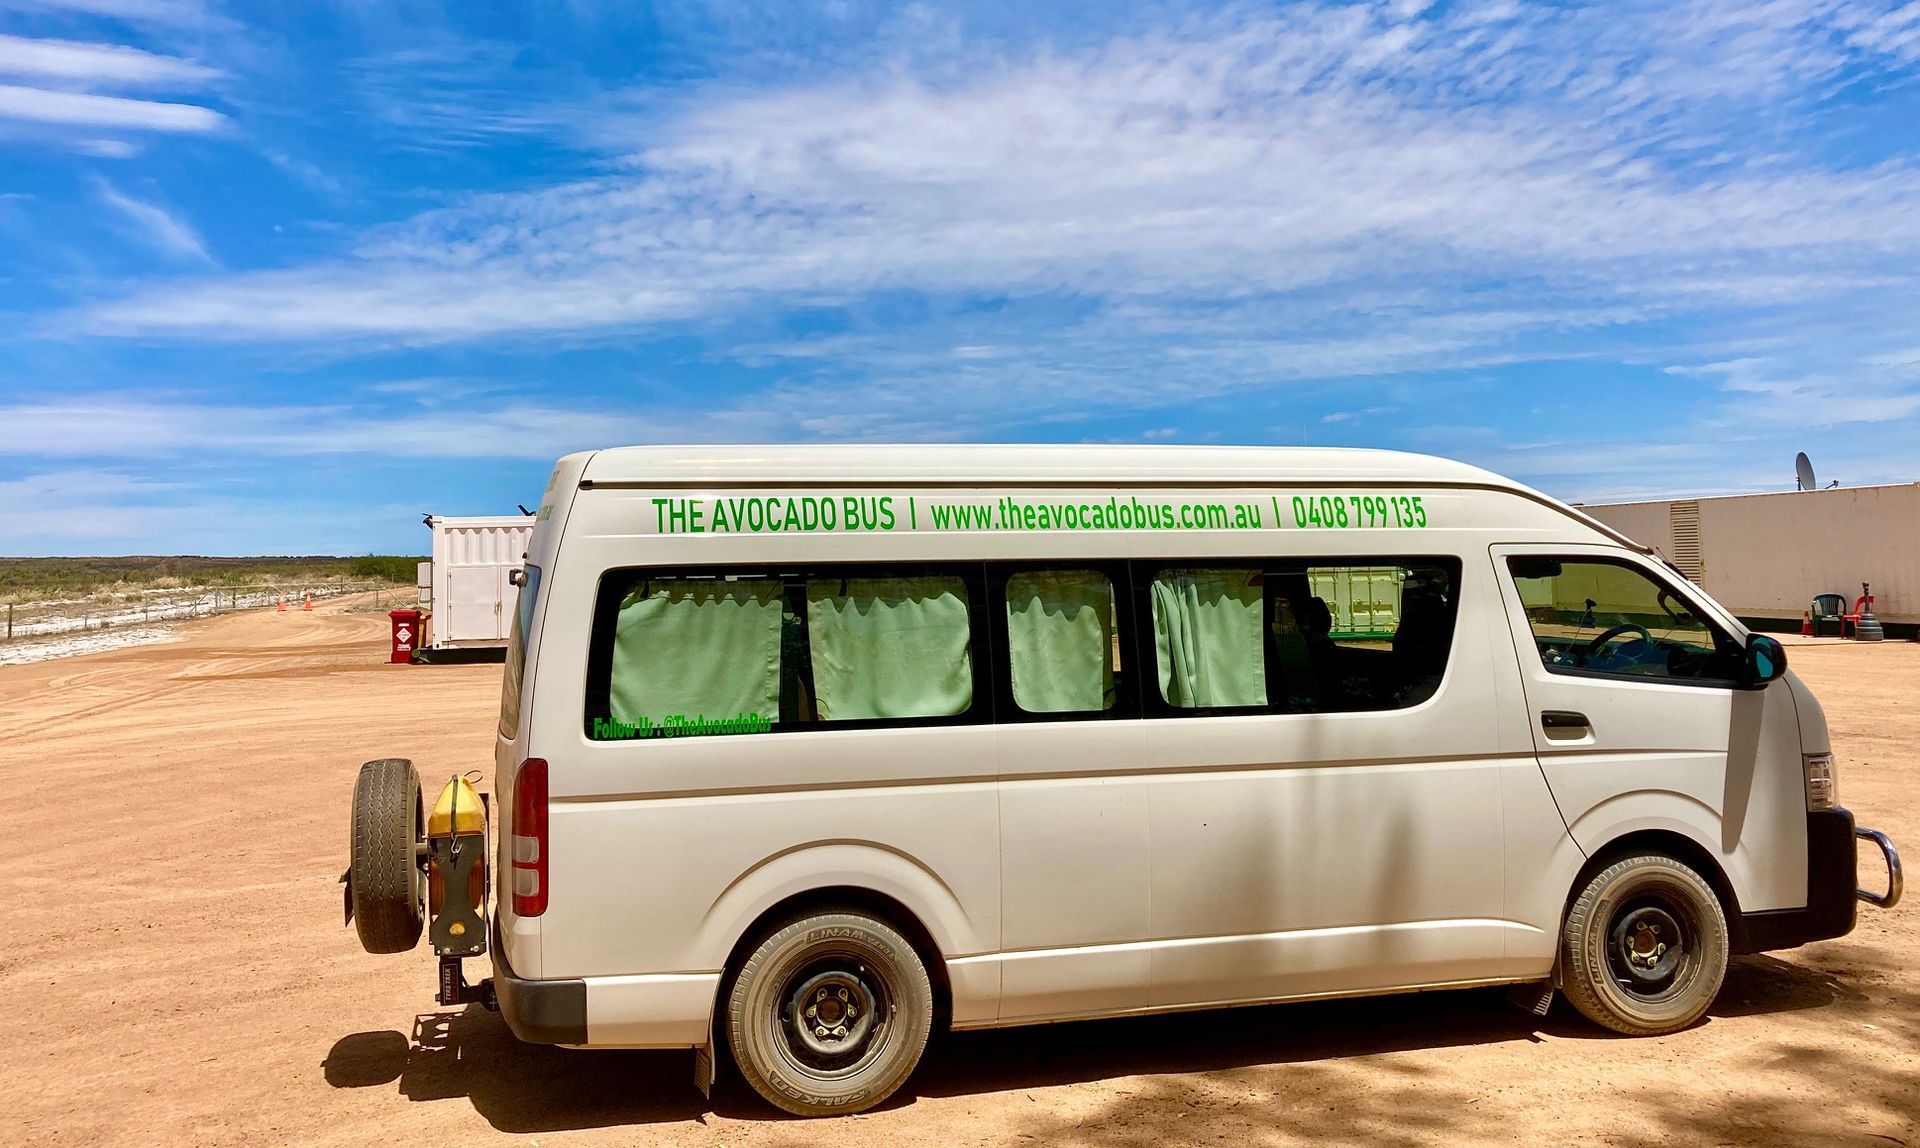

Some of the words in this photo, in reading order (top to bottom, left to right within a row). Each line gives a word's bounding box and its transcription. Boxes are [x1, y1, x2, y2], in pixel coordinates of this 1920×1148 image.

[652, 498, 705, 534] THE
[711, 496, 837, 533] AVOCADO
[842, 496, 896, 531] BUS
[930, 496, 1262, 530] www.theavocadobus.com.au
[1292, 496, 1349, 529] 0408
[1349, 496, 1388, 528] 799
[1390, 496, 1427, 528] 135
[593, 717, 636, 739] Follow
[639, 716, 654, 738] Us
[663, 712, 772, 738] @TheAvocadoBus
[808, 928, 864, 941] LINAM
[772, 1076, 867, 1107] FALKEN
